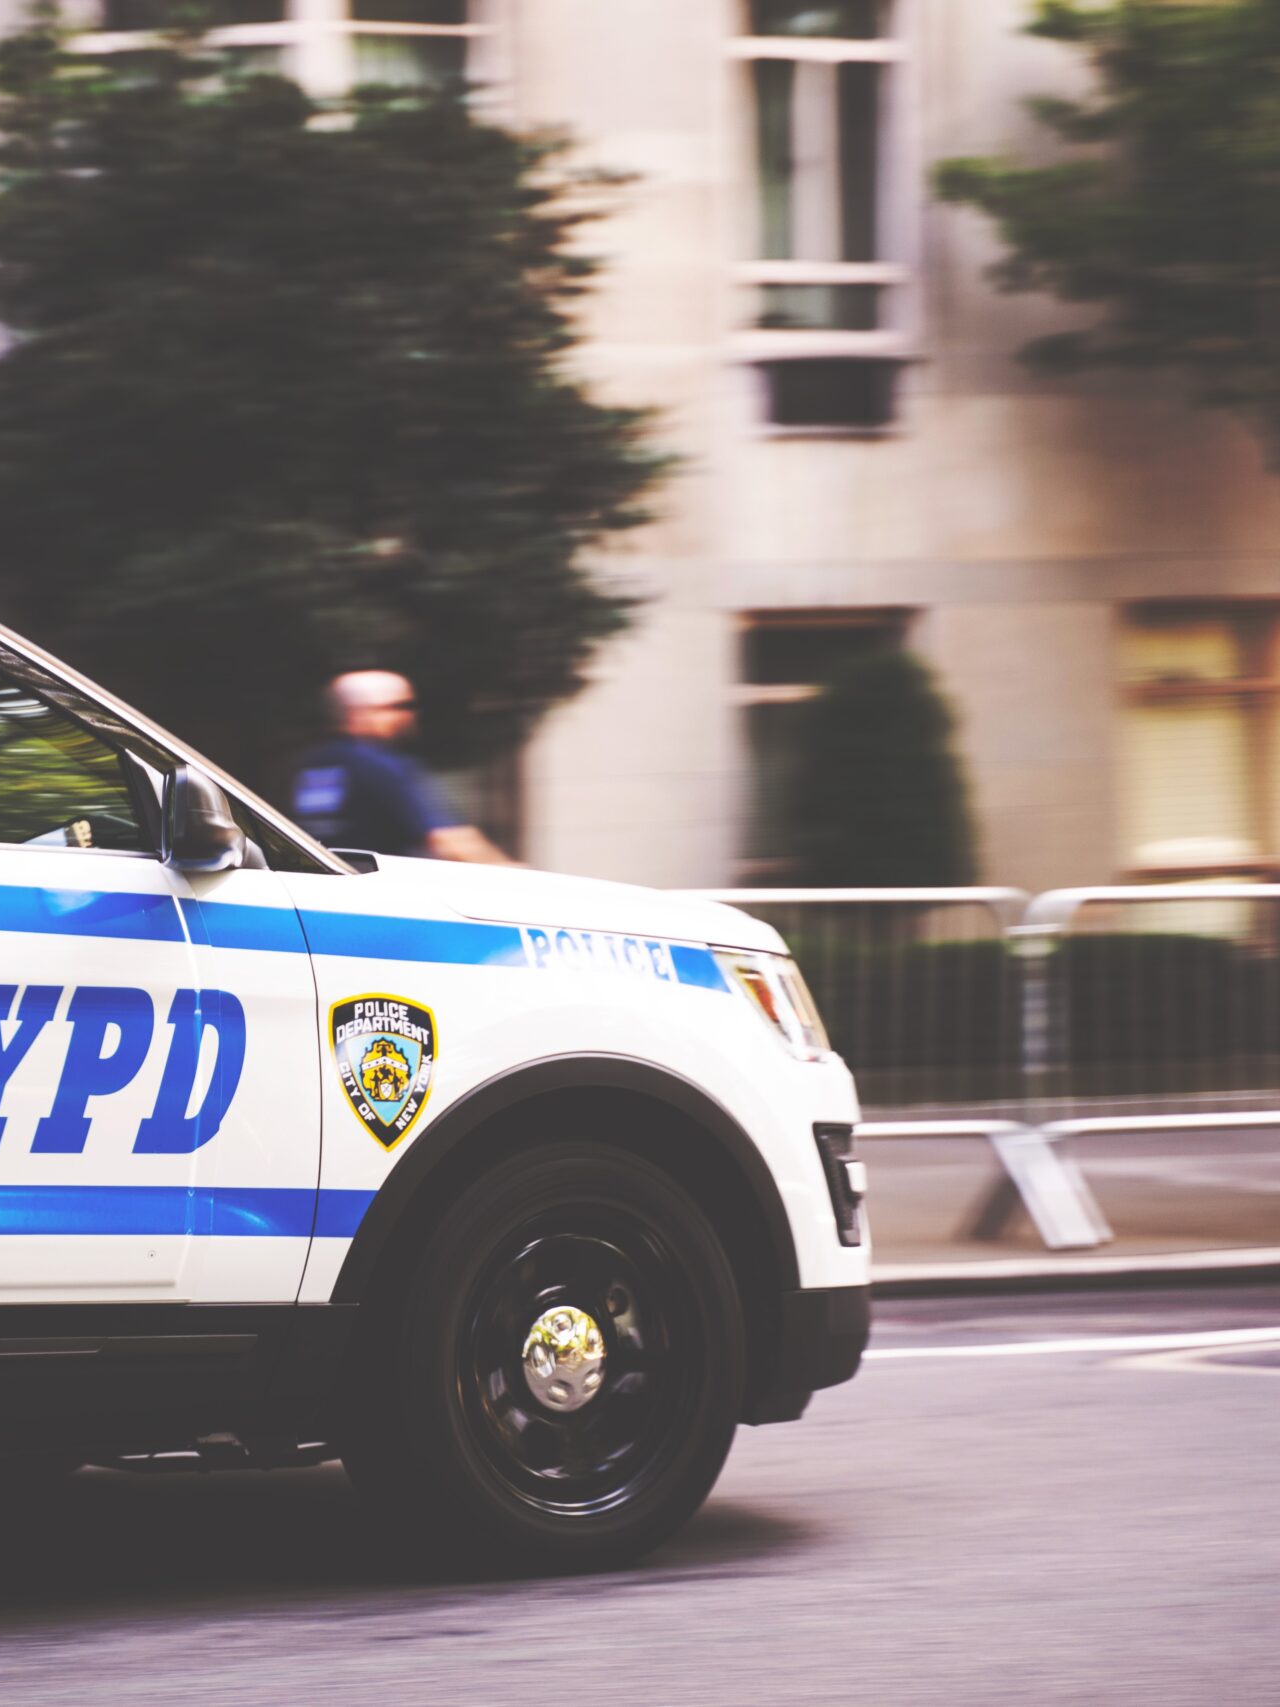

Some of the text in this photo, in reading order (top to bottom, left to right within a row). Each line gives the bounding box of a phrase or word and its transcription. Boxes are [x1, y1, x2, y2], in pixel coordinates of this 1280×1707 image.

[354, 1001, 409, 1021] POLICE
[336, 1017, 430, 1045] DEPARTMENT
[339, 1054, 433, 1130] CITY OF NEW YORK
